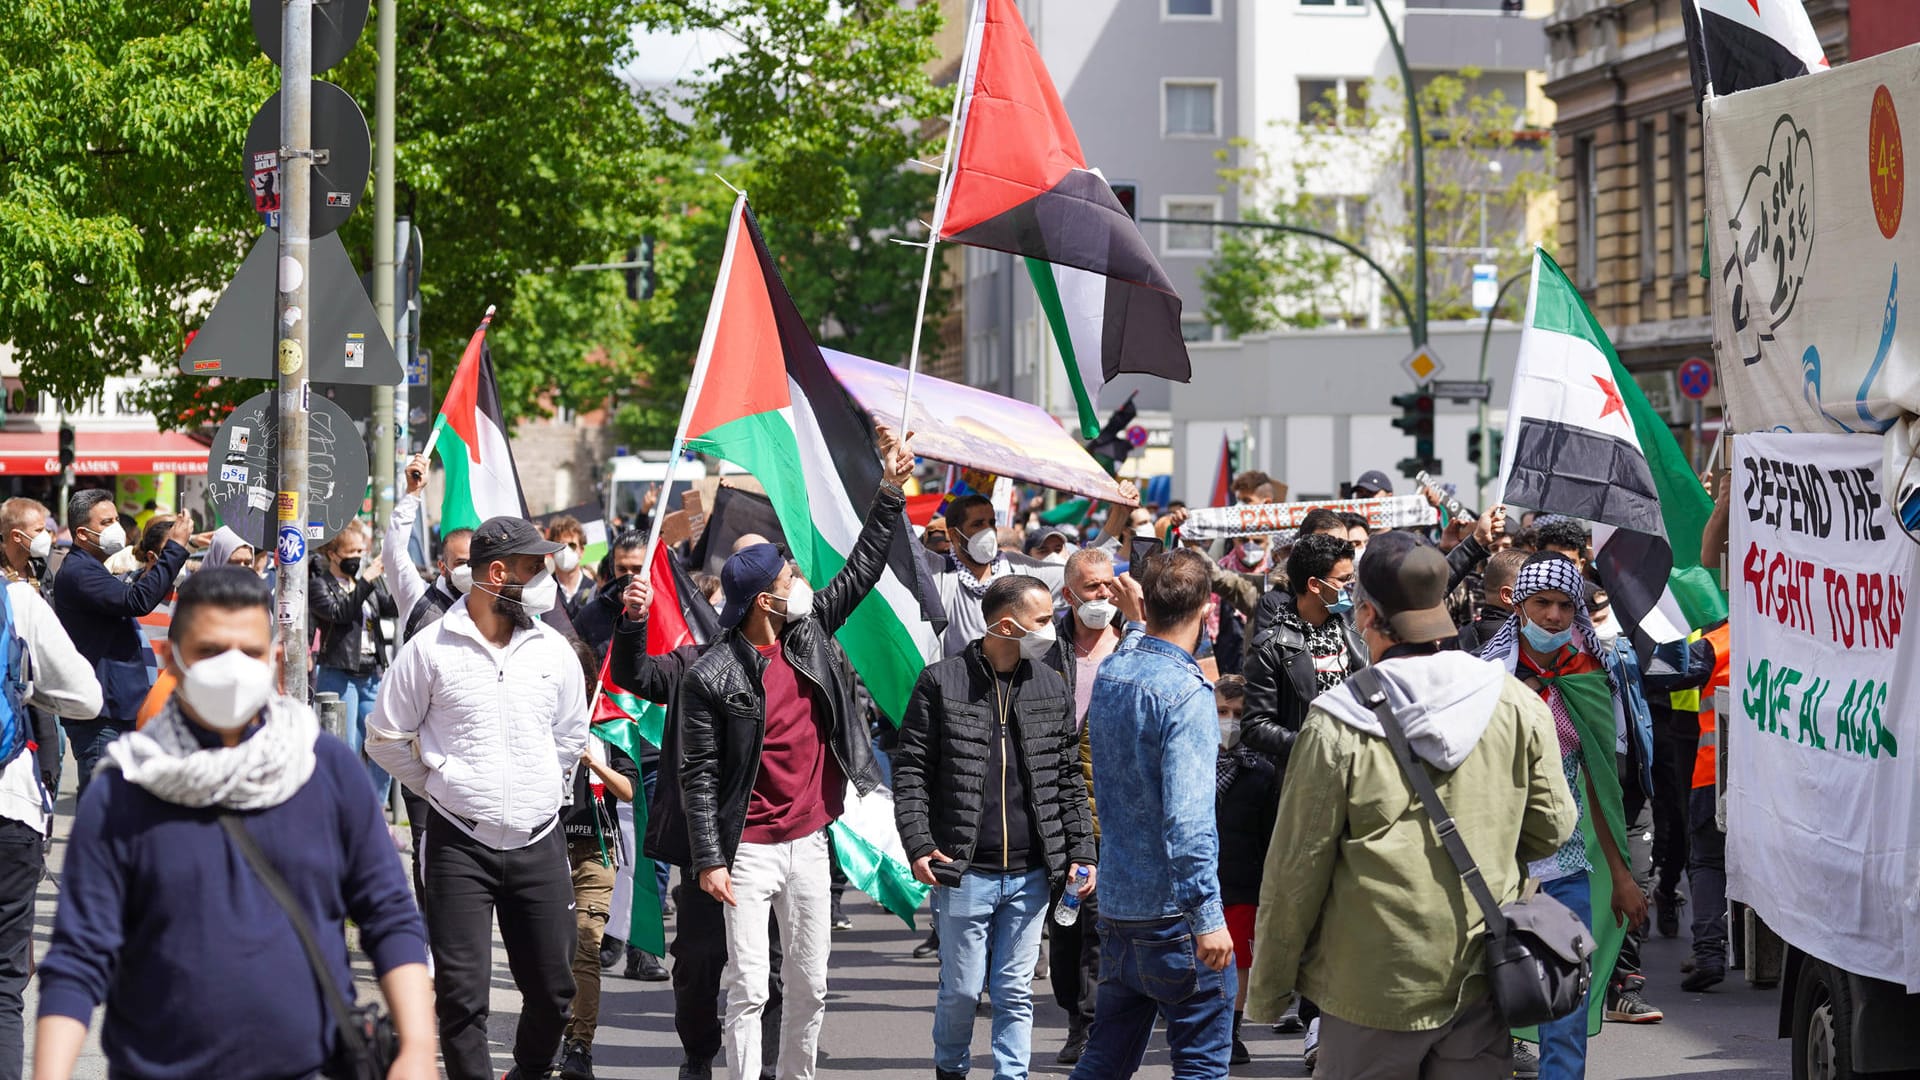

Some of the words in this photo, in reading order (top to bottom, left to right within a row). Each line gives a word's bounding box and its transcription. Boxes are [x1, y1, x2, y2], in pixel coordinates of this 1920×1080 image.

[1744, 201, 1769, 268] ab
[1773, 136, 1794, 226] std
[153, 461, 208, 472] RESTAURAN
[1744, 456, 1832, 538] DEFEND
[1828, 467, 1886, 541] THE
[1240, 502, 1382, 530] PALENE
[1743, 541, 1815, 635] RIGHT
[1824, 568, 1854, 649] TO
[1798, 676, 1830, 750] AL
[565, 824, 592, 834] HAPPEN
